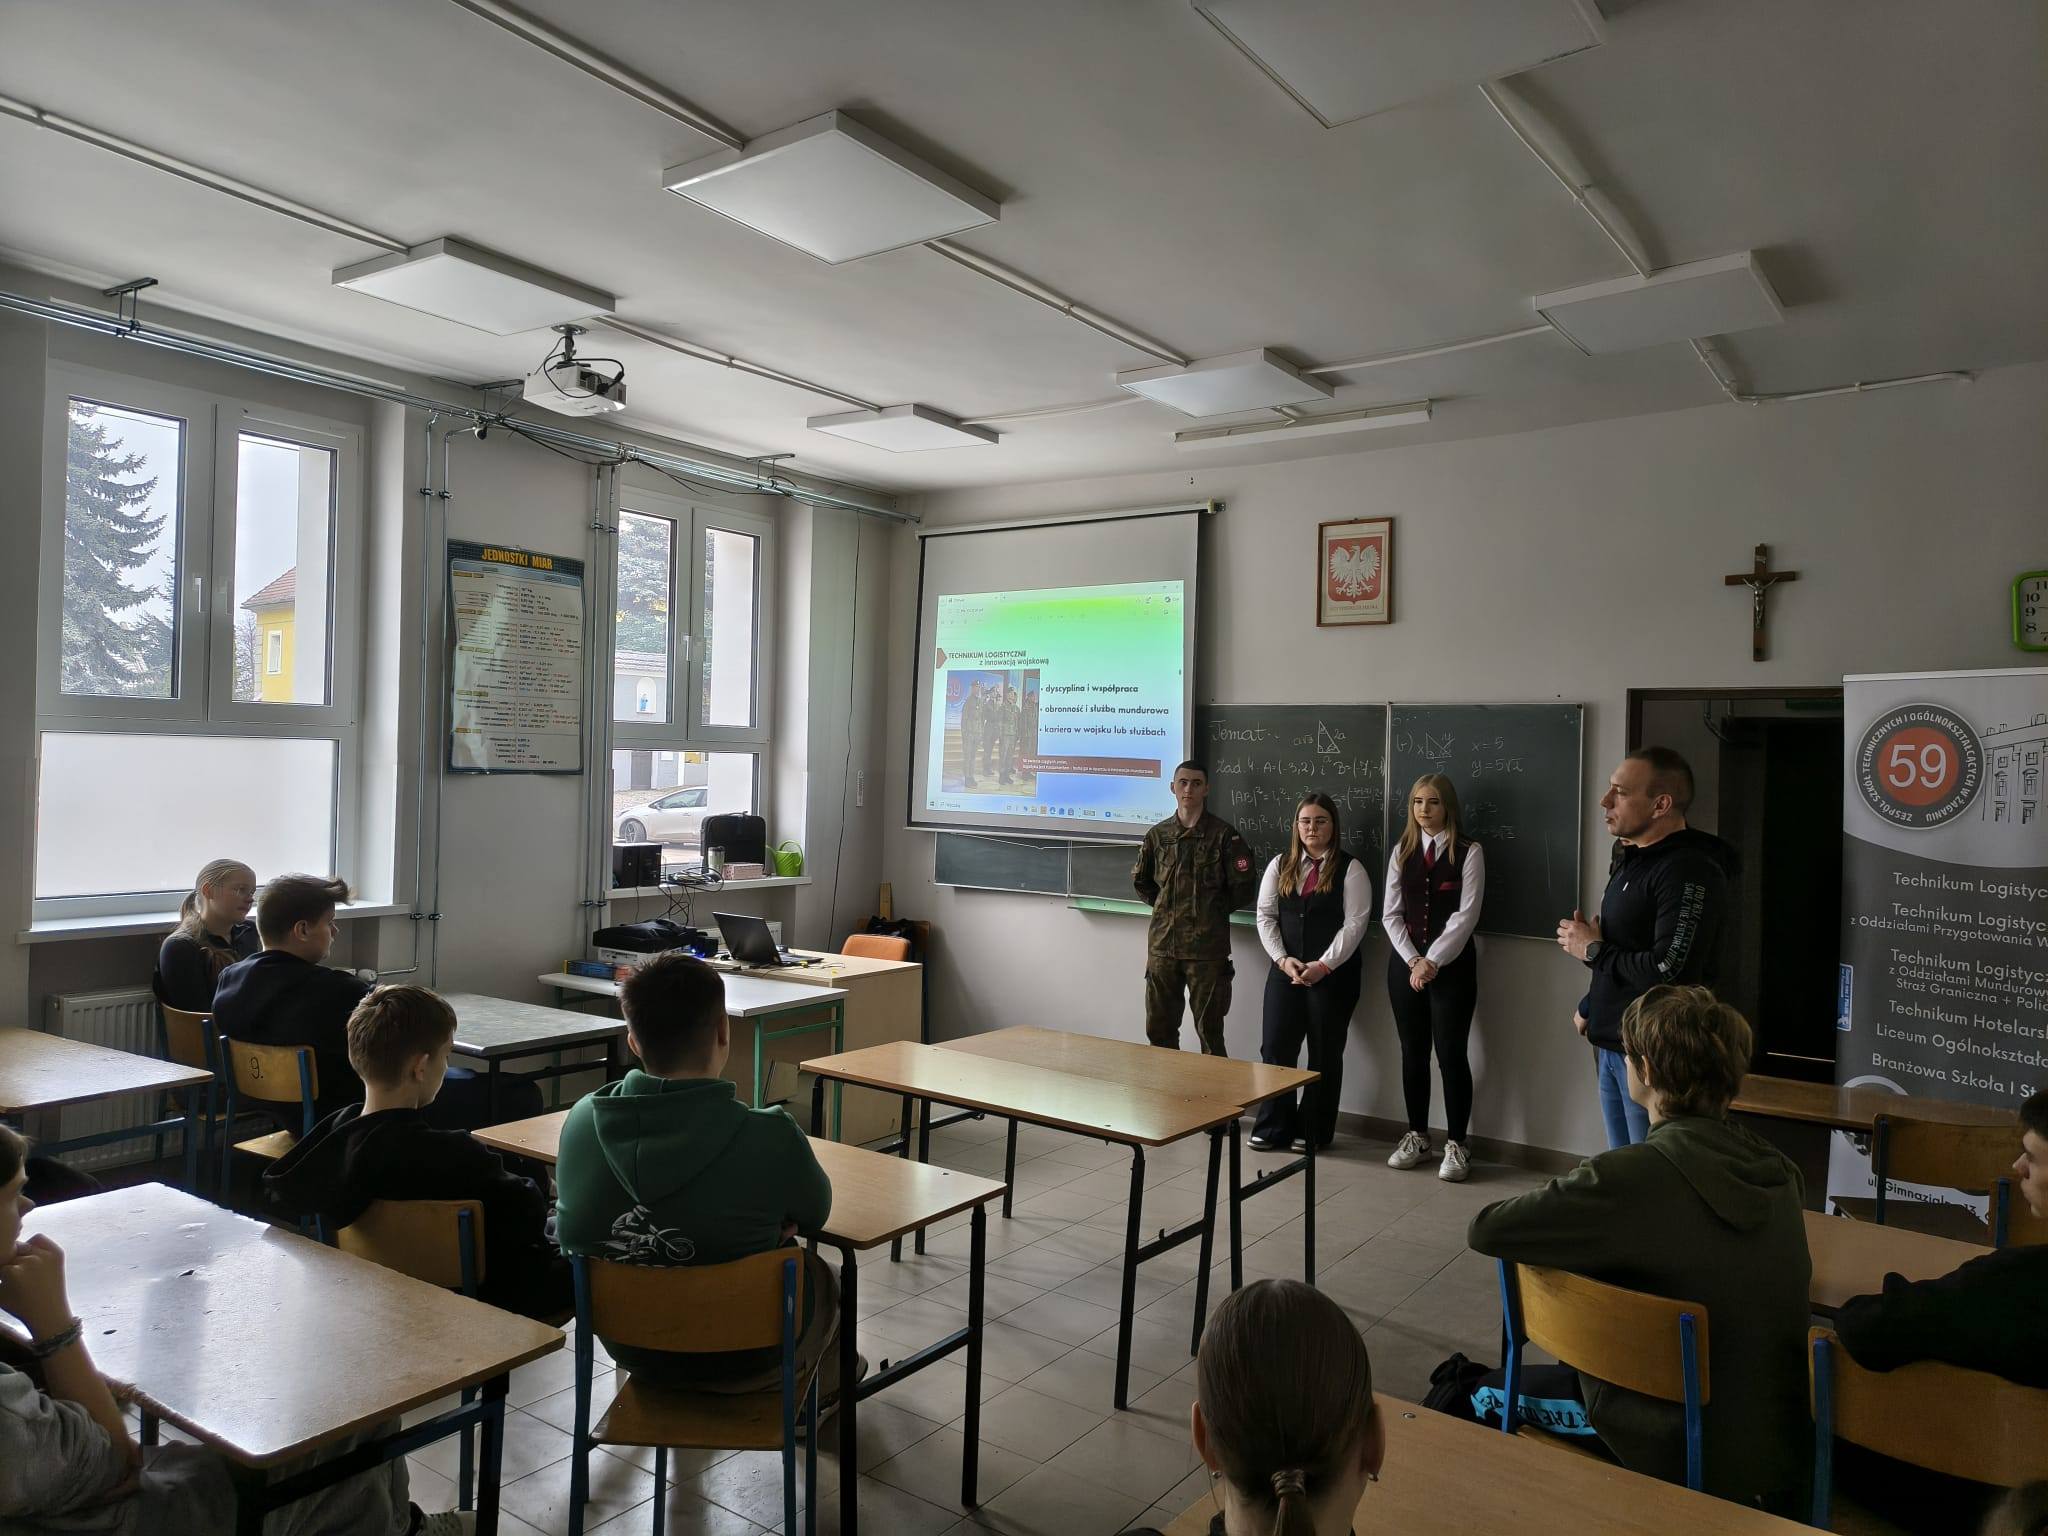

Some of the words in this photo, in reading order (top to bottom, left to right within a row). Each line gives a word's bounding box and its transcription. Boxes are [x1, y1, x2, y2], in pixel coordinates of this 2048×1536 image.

[482, 548, 528, 566] JEDNOSTKI
[532, 555, 553, 570] MIAR
[2026, 592, 2040, 602] 10
[2025, 607, 2036, 616] 9
[2025, 622, 2037, 632] 8
[984, 659, 1016, 667] innowacją
[1017, 658, 1049, 666] wojskową
[1045, 684, 1085, 694] dyscyplina
[1087, 684, 1090, 692] i
[1092, 684, 1139, 694] współpraca
[1045, 704, 1084, 713] obronność
[1085, 704, 1088, 713] i
[1090, 704, 1115, 713] służba
[1118, 706, 1169, 715] mundurowa
[1044, 725, 1072, 733] kariera
[1083, 725, 1111, 735] wojsku
[1114, 726, 1127, 735] lub
[1129, 727, 1166, 736] służbach
[1862, 715, 1903, 773] TECHNICZNYCH
[1909, 711, 1977, 785] OGÓLNOKSZTAŁCĄCYCH
[1888, 744, 1946, 788] 59
[1862, 776, 1881, 802] SZKÓŁ
[1962, 787, 1971, 797] W
[1879, 799, 1912, 822] ZESPÓŁ
[1893, 872, 1974, 891] Technikum
[1892, 902, 1972, 923] Technikum
[1850, 917, 1856, 925] z
[1859, 916, 1930, 933] Oddziałami
[1933, 923, 2033, 946] Przygotowania
[1890, 949, 1970, 971] Technikum
[1888, 966, 1895, 975] z
[1899, 966, 1970, 986] Oddziałami
[1896, 978, 1926, 992] Straż
[1930, 984, 1997, 1003] Graniczna
[1889, 1000, 1968, 1025] Technikum
[1973, 1014, 2048, 1039] Hotelars
[1877, 1023, 1926, 1044] Liceum
[1872, 1053, 1947, 1081] Branżowa
[1952, 1069, 2004, 1093] Szkoła
[2010, 1081, 2014, 1095] I
[2020, 1084, 2038, 1098] St
